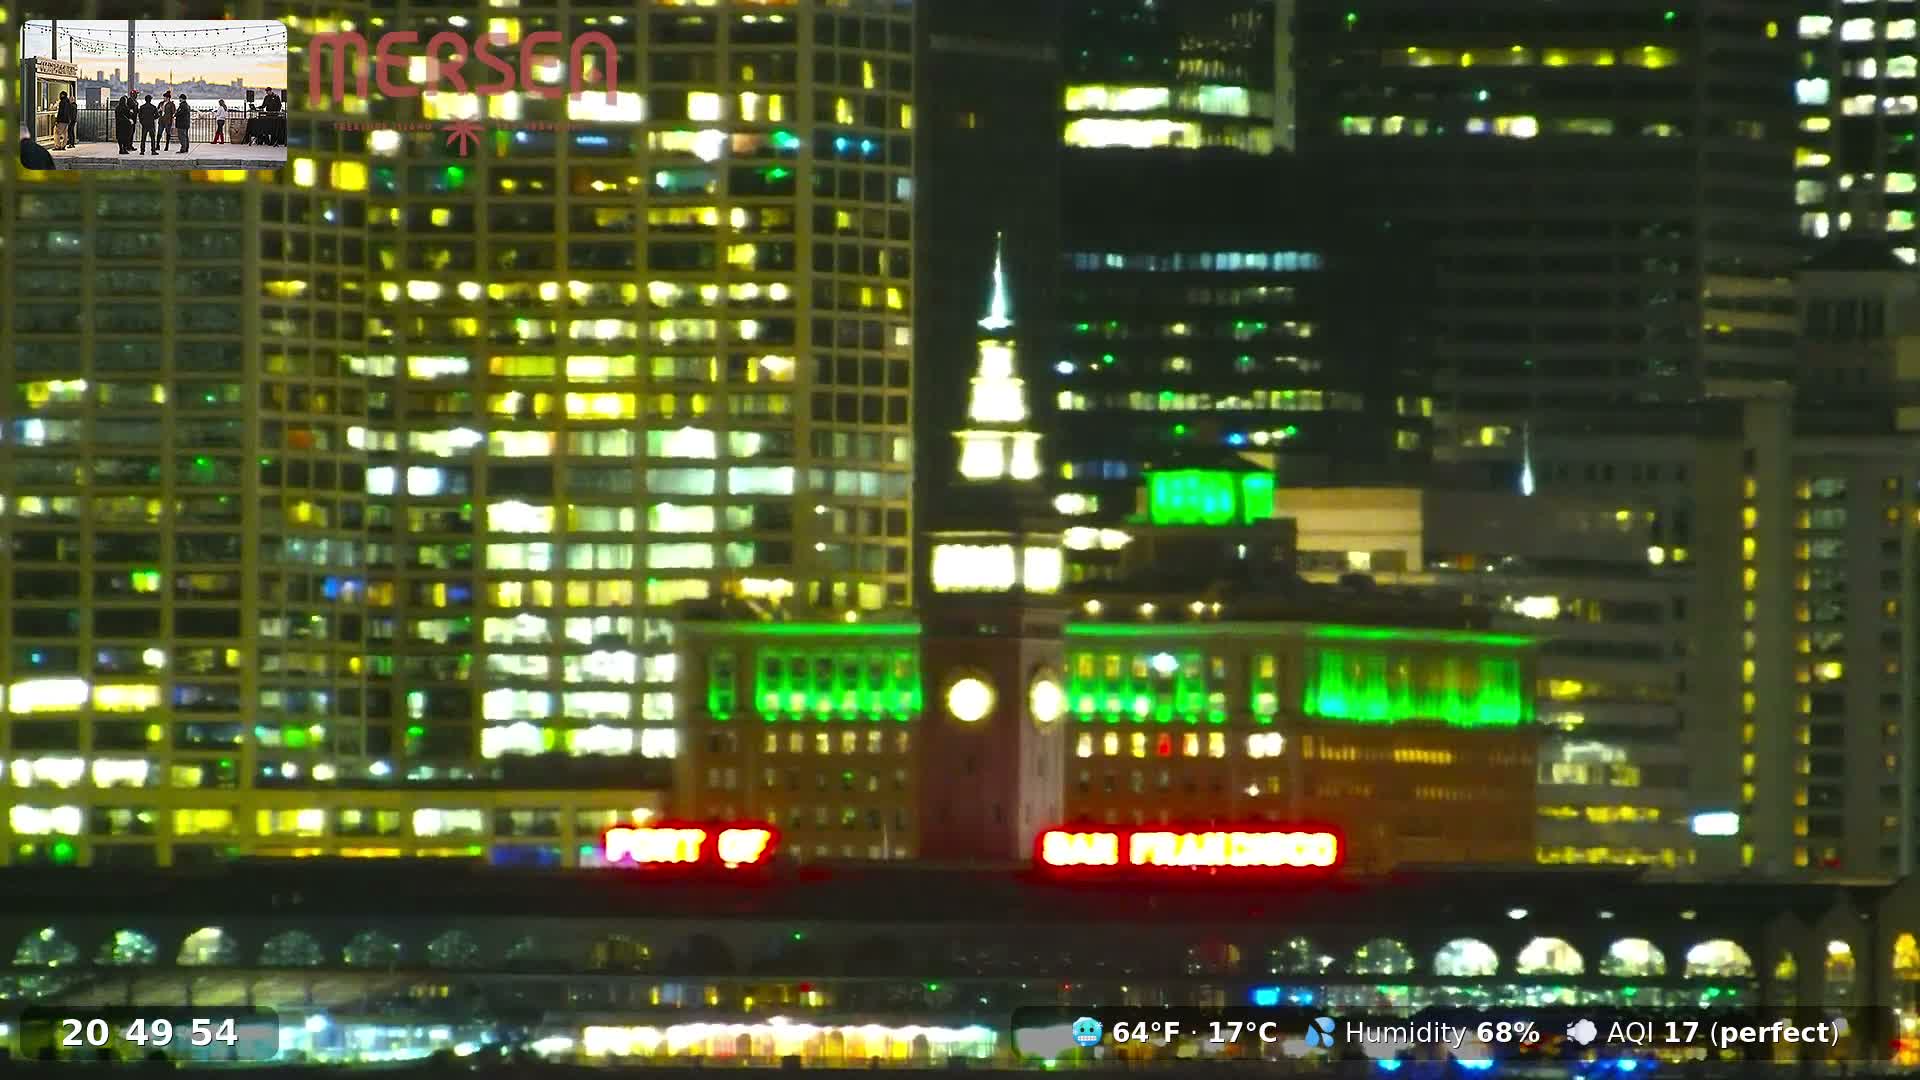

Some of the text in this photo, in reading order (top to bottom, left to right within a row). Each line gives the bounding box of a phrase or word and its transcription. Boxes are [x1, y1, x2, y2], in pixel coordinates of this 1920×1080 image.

[605, 827, 772, 864] PORT OF
[1042, 830, 1338, 867] SAN FRANCISCO
